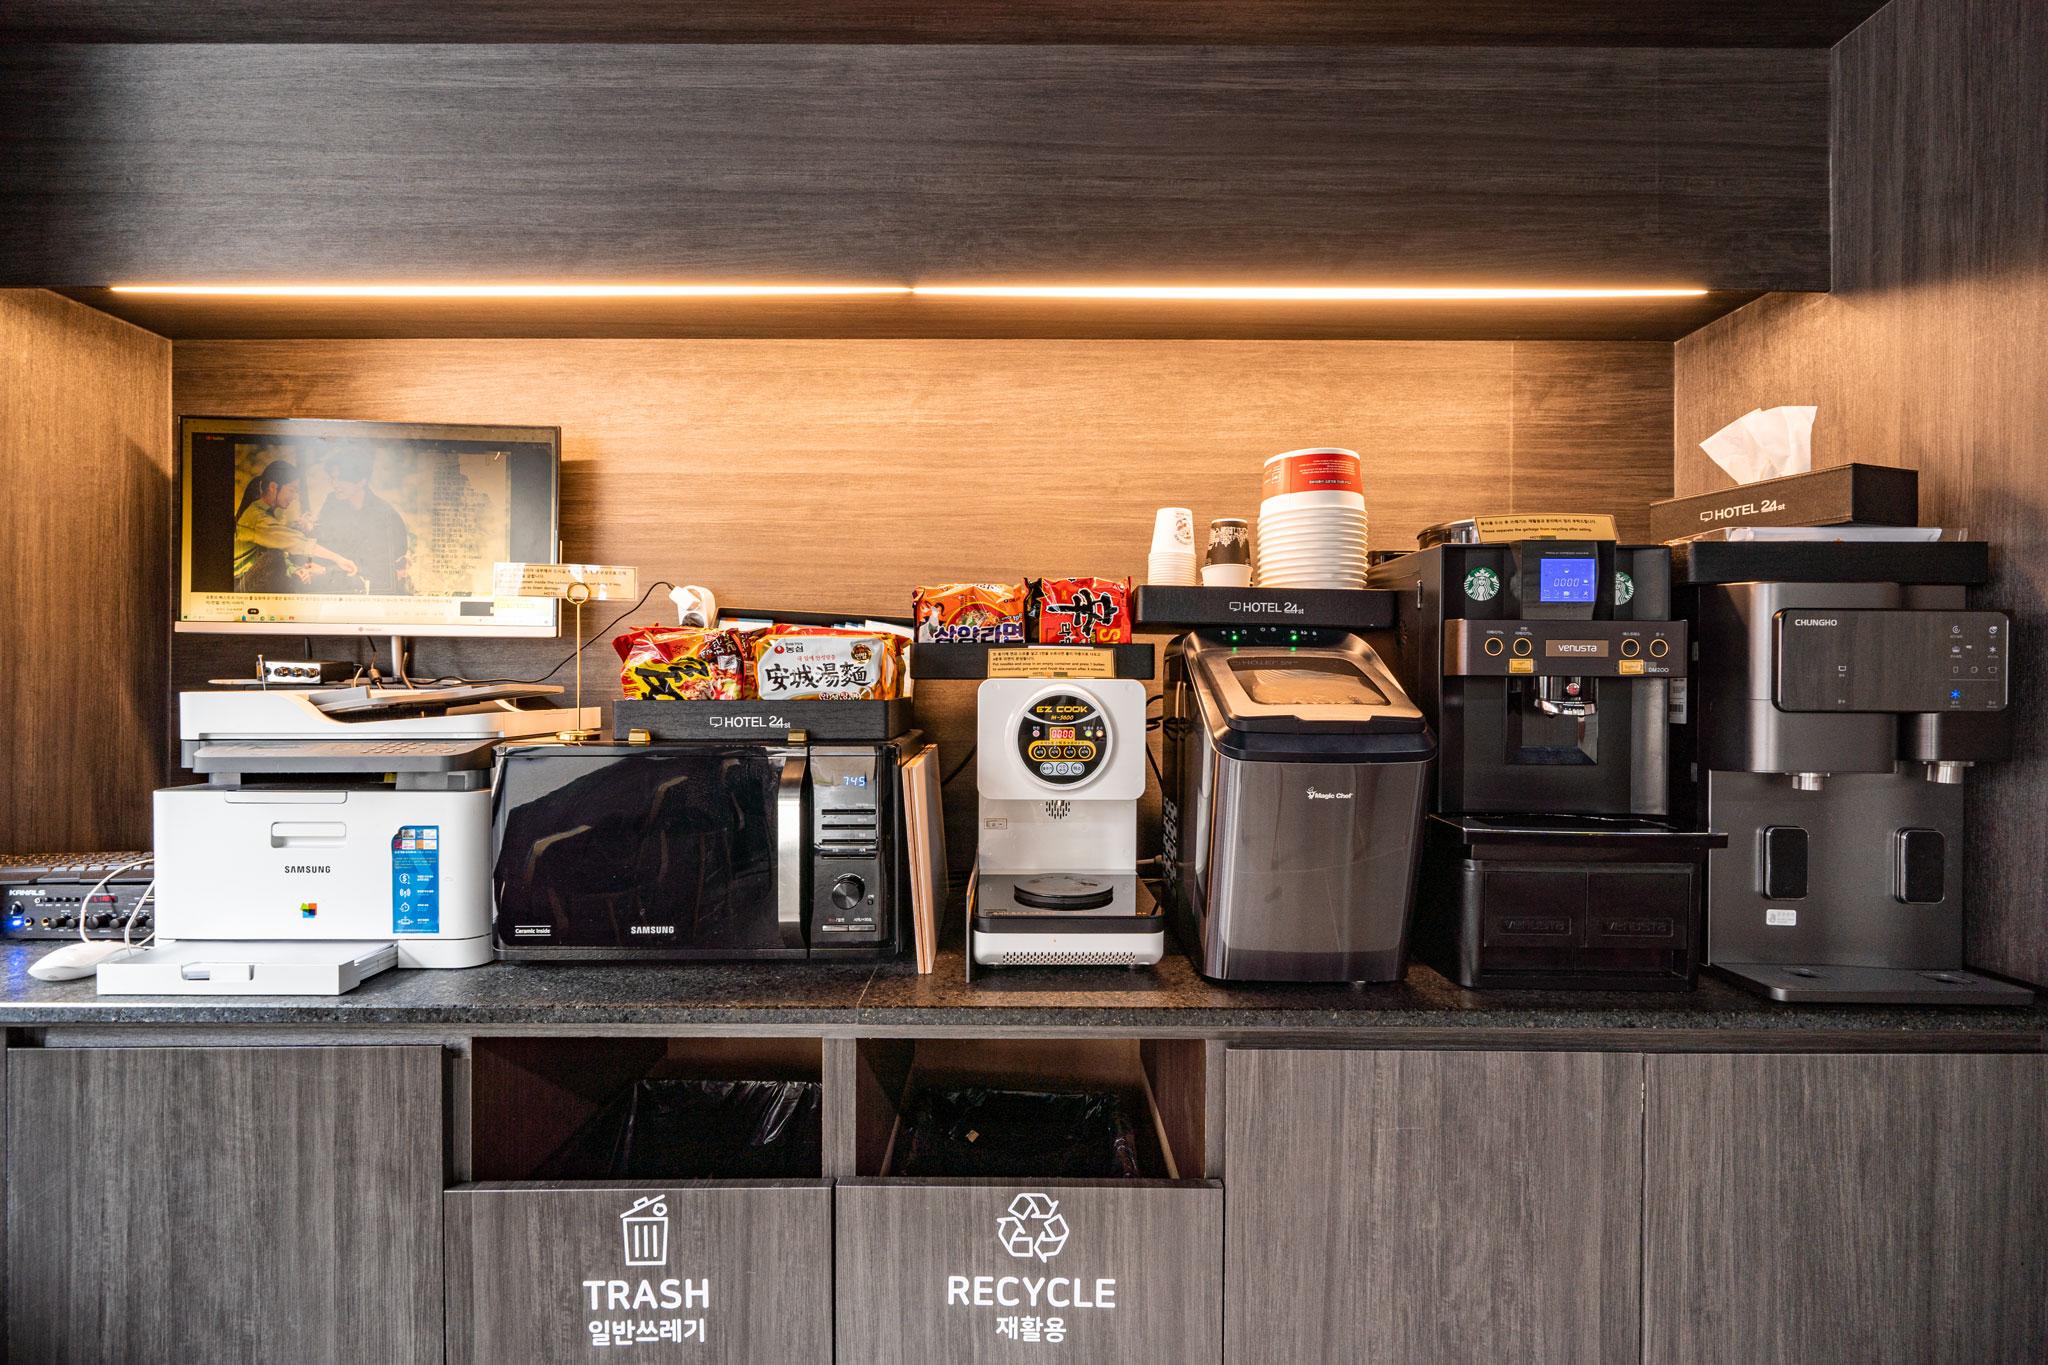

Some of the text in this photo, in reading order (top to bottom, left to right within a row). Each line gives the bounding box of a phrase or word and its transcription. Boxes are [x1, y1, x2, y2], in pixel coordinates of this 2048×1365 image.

[1714, 503, 1759, 520] HOTEL
[1243, 602, 1283, 613] HOTEL
[1036, 705, 1088, 713] EZ COOK
[724, 716, 767, 728] HOTEL
[1314, 792, 1335, 800] Magic
[284, 865, 331, 874] SAMSUNG
[630, 926, 674, 934] SAMSUNG
[583, 1279, 709, 1310] TRASH
[948, 1275, 1116, 1308] RECYCLE
[588, 1318, 706, 1347] 일반쓰레기
[995, 1315, 1067, 1343] 재활용
